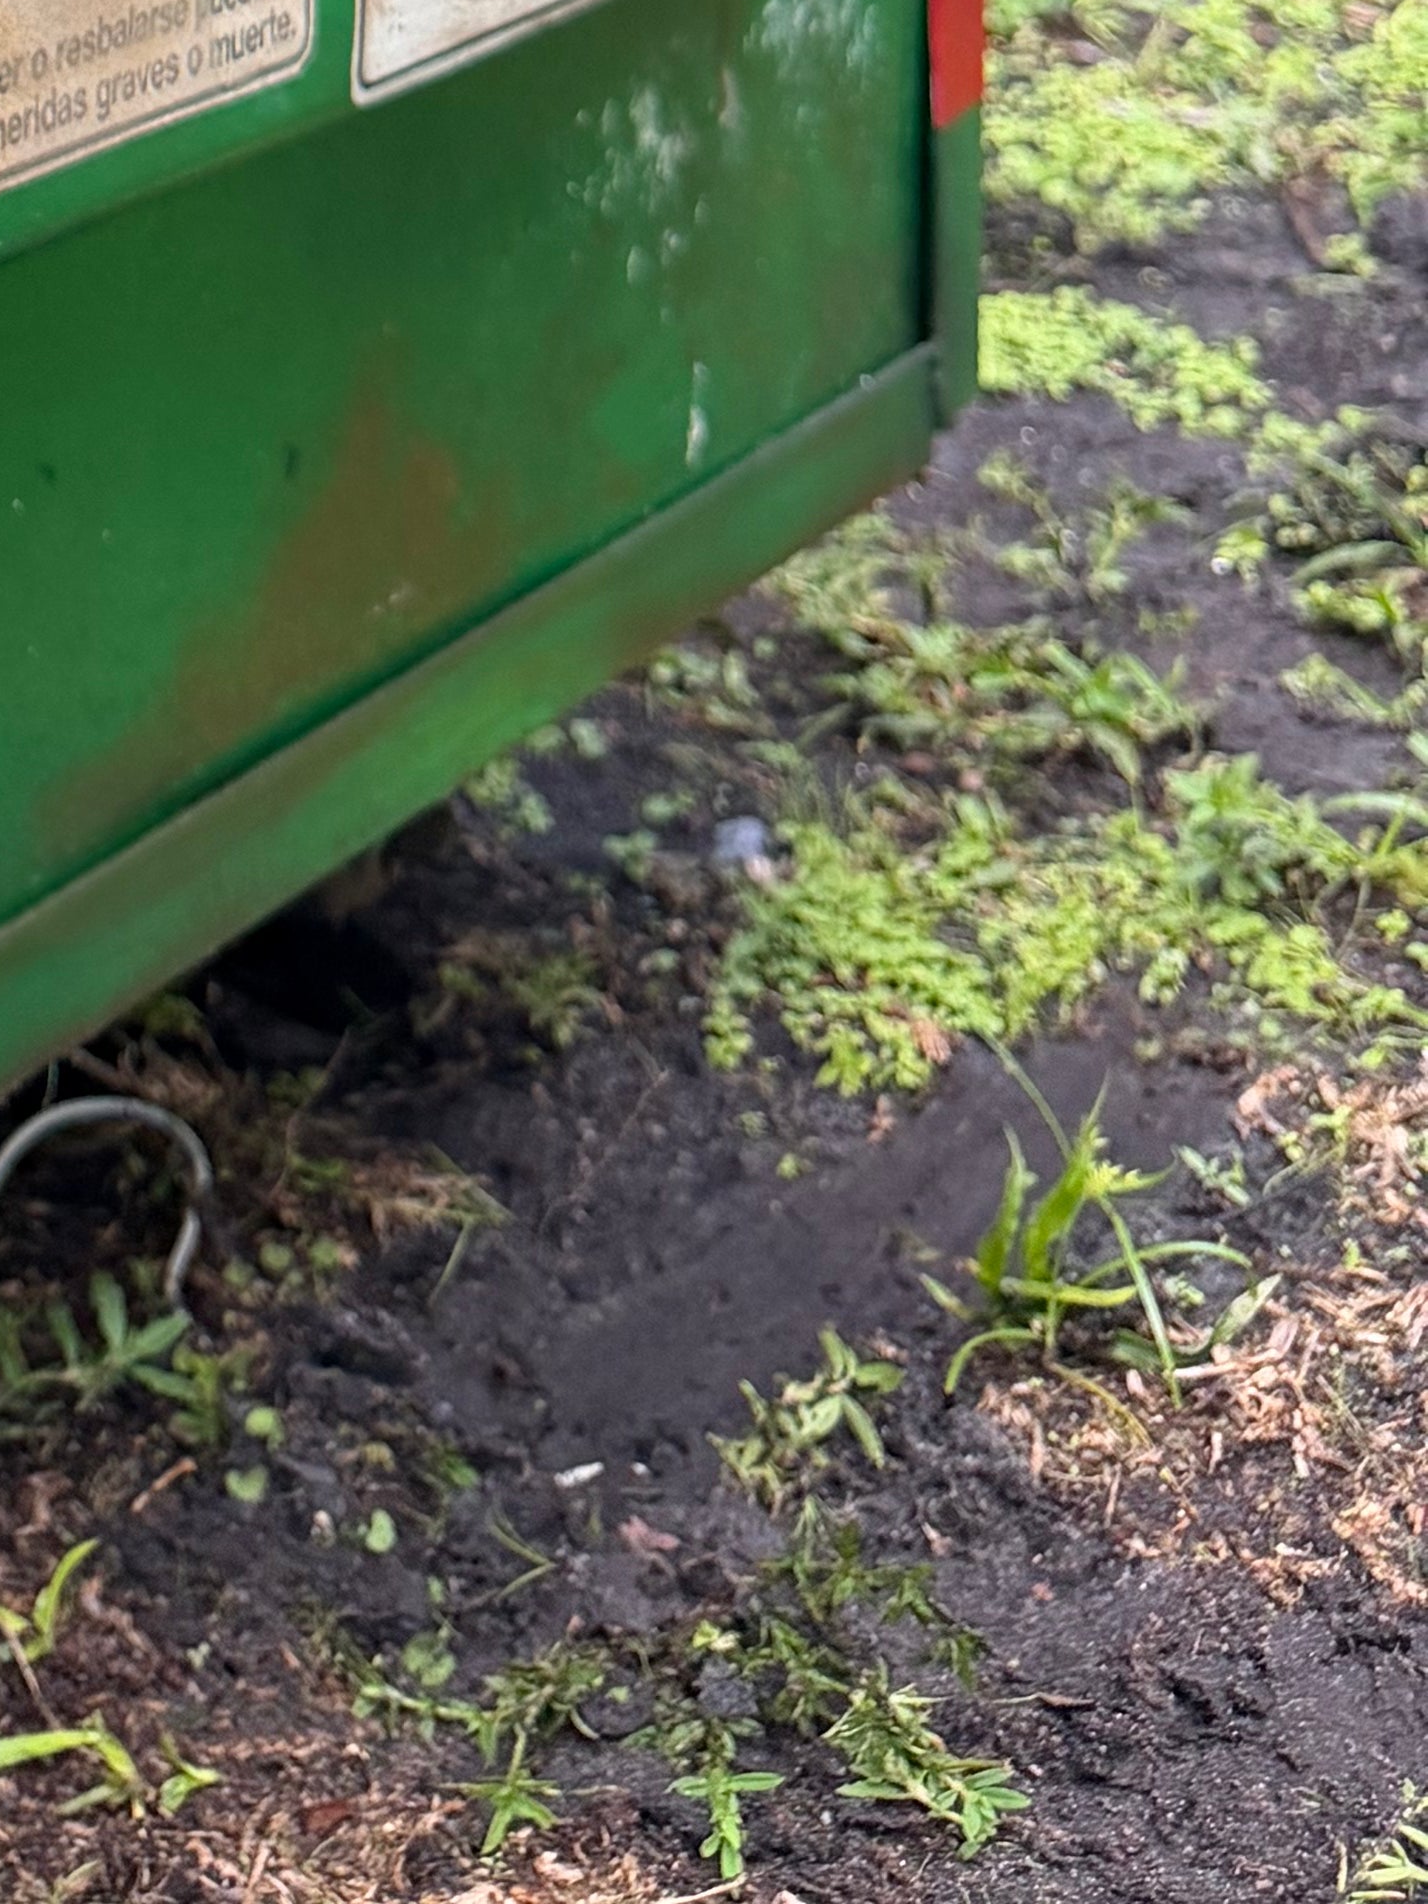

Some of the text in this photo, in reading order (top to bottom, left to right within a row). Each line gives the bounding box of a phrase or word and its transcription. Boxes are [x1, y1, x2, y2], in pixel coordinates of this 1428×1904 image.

[28, 49, 48, 79] o
[96, 53, 179, 112] graves
[187, 45, 204, 77] o
[210, 10, 296, 67] muerte.
